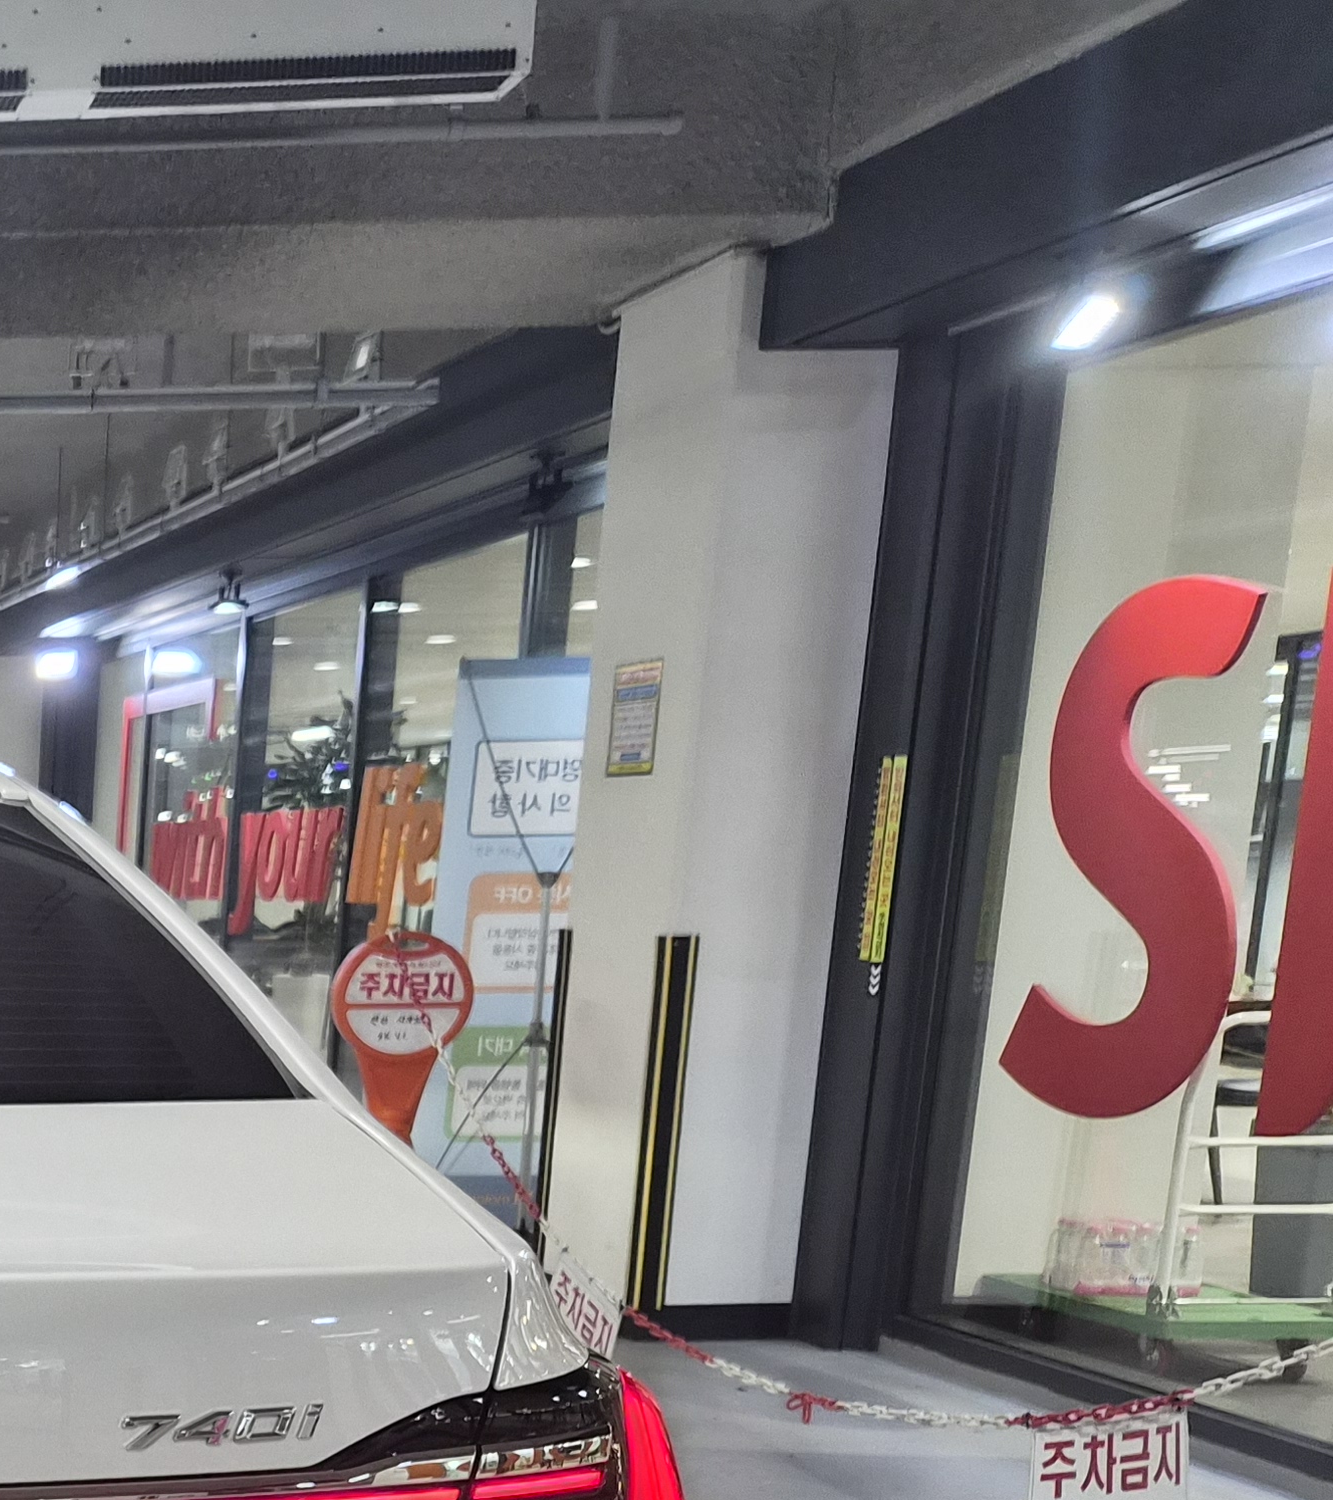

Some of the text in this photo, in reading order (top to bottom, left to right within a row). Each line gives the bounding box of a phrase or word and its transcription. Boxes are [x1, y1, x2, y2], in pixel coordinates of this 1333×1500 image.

[227, 806, 347, 936] your
[554, 1269, 614, 1356] 주차금지
[120, 1403, 324, 1452] 740i
[1039, 1420, 1181, 1500] 주차금지
